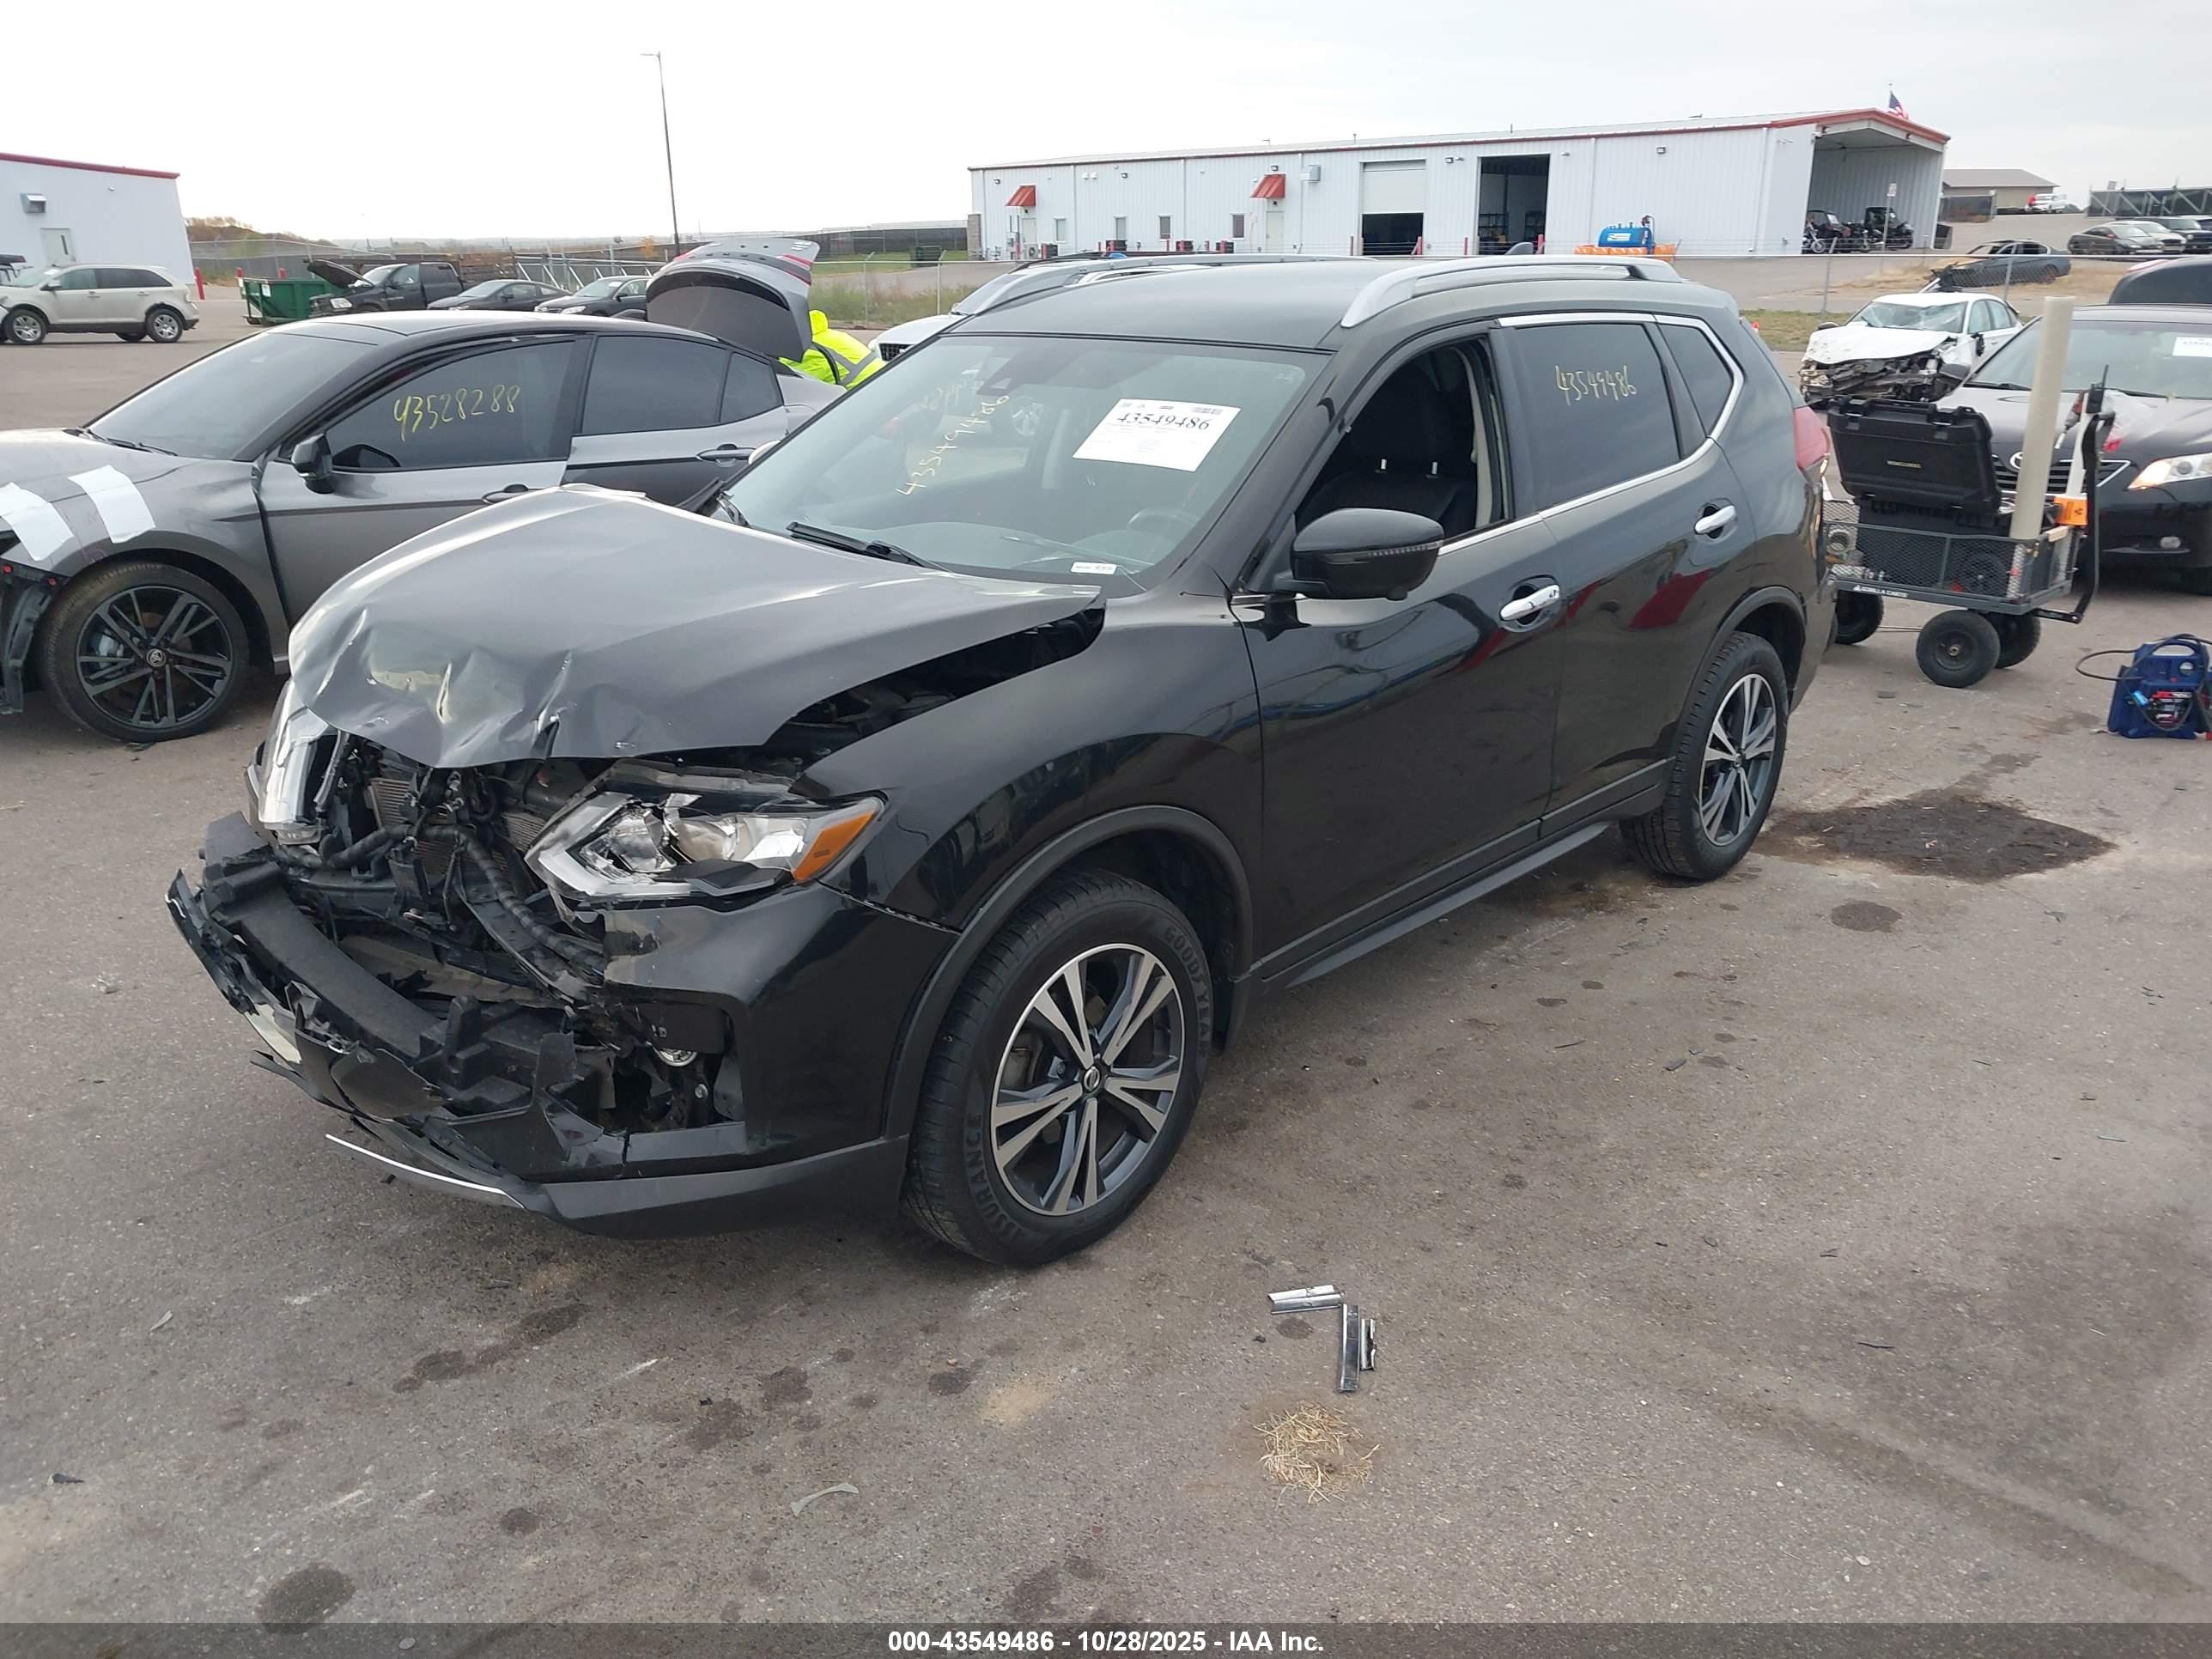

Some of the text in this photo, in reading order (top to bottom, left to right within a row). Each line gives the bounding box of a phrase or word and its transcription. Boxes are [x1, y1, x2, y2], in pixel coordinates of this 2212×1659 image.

[1555, 364, 1637, 405] 43549486
[394, 385, 520, 441] 43528288
[1117, 412, 1212, 430] 43549486
